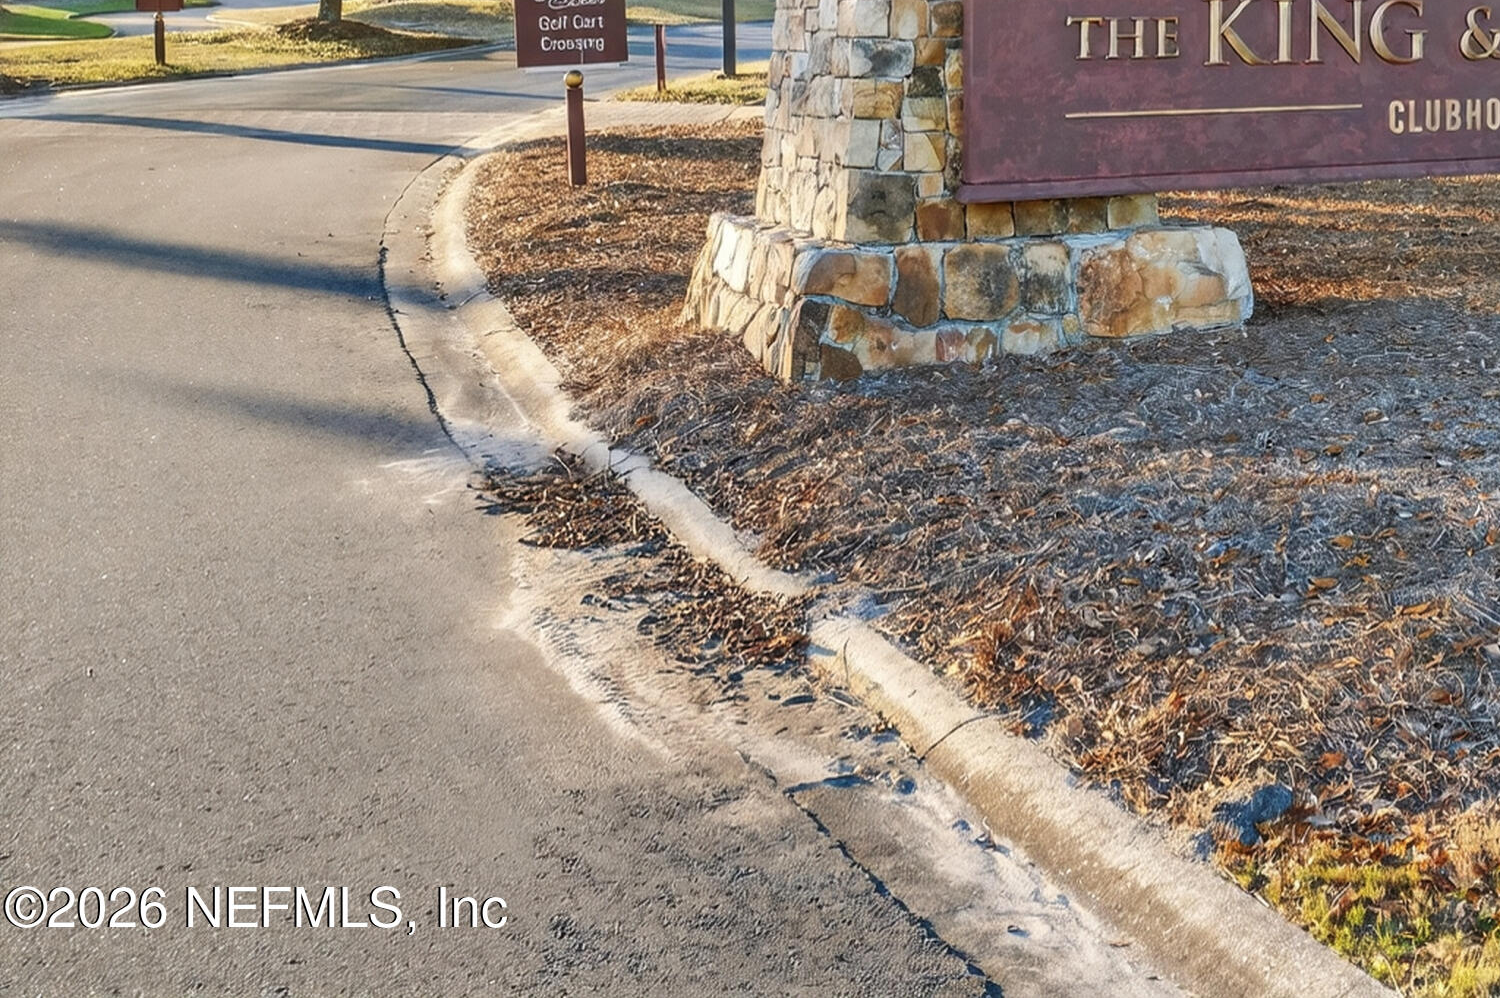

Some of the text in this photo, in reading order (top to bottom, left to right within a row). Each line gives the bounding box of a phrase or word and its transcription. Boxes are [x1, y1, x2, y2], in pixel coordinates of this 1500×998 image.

[538, 14, 604, 31] Golf Cart
[1065, 16, 1180, 60] THE
